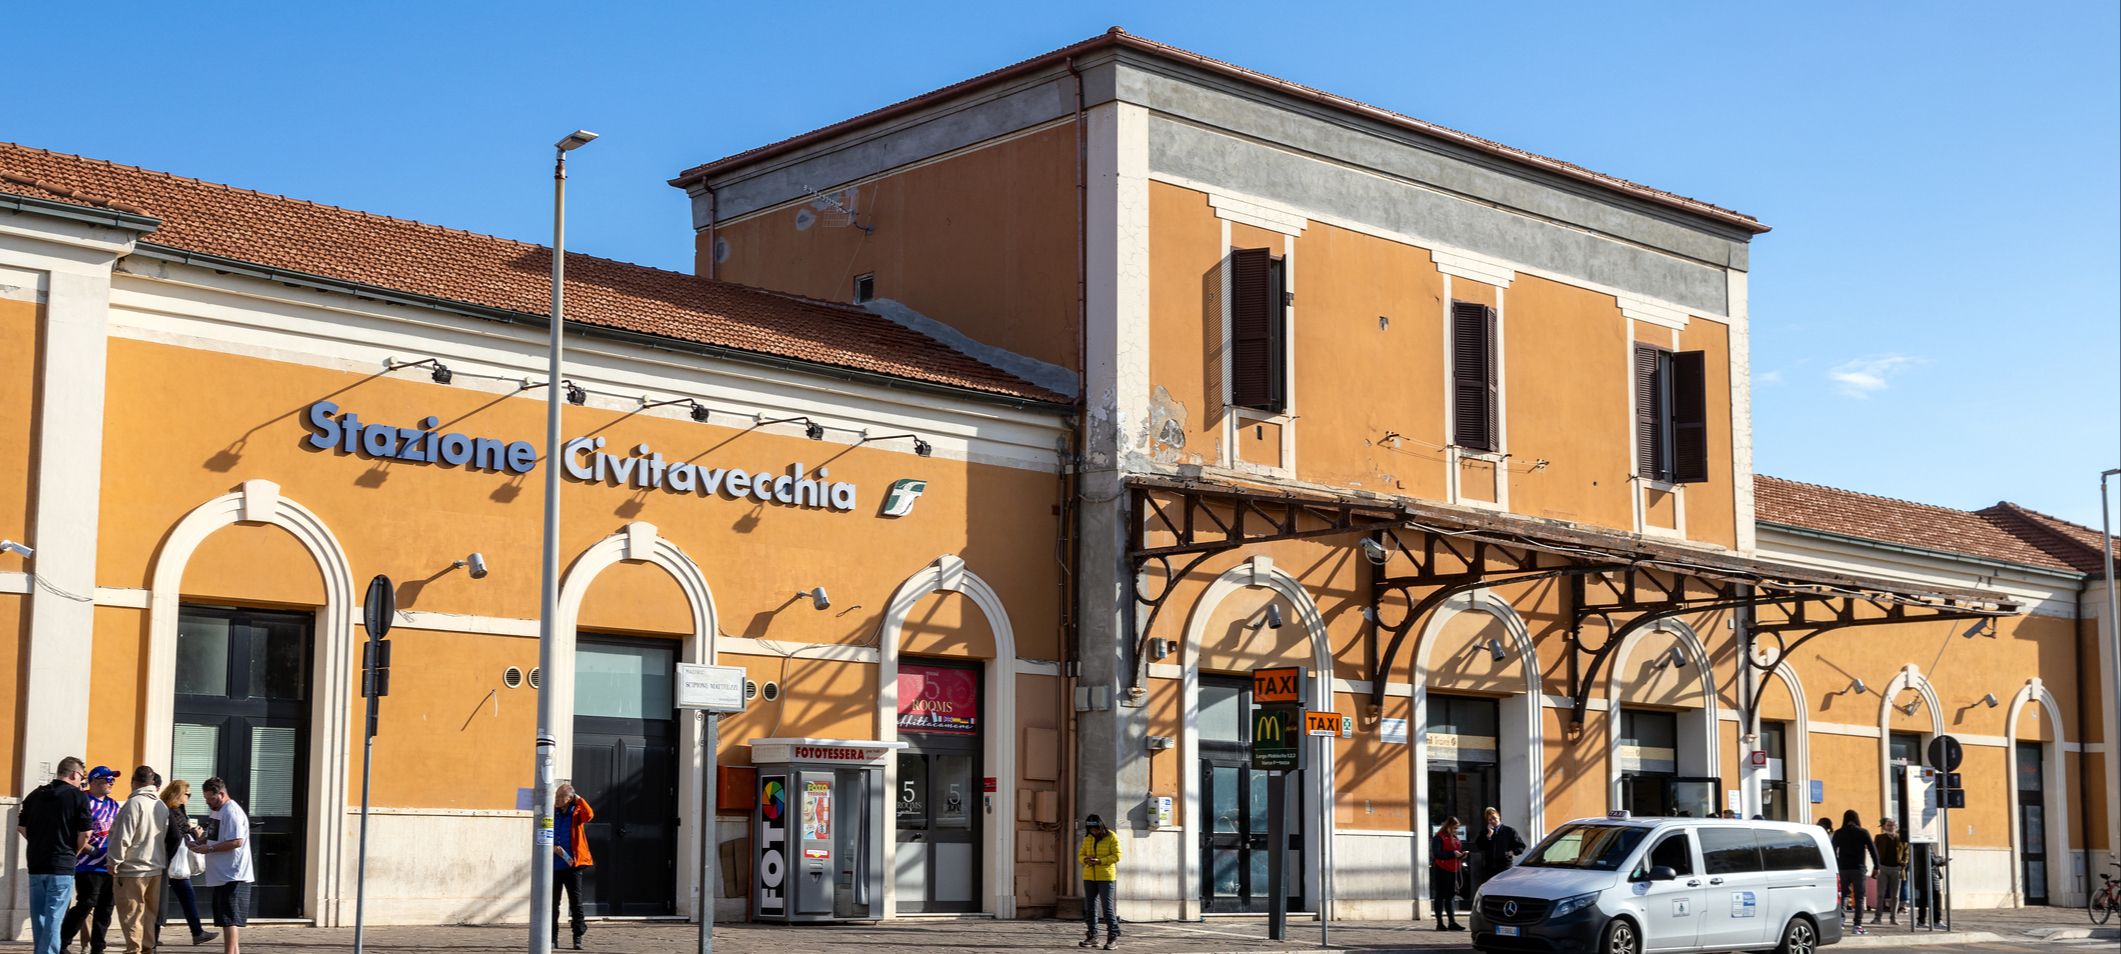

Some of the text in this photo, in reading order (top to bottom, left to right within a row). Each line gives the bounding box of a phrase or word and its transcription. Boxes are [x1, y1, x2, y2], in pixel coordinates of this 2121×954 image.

[309, 400, 858, 511] Stazione Civitavecchia
[924, 671, 941, 700] 5
[1255, 675, 1297, 695] TAXI
[912, 699, 953, 712] ROOMS
[1308, 716, 1339, 732] TAXI
[795, 746, 865, 760] FOTOTESSERA
[807, 784, 829, 792] FOTO
[902, 781, 916, 803] 5
[948, 783, 961, 805] 5
